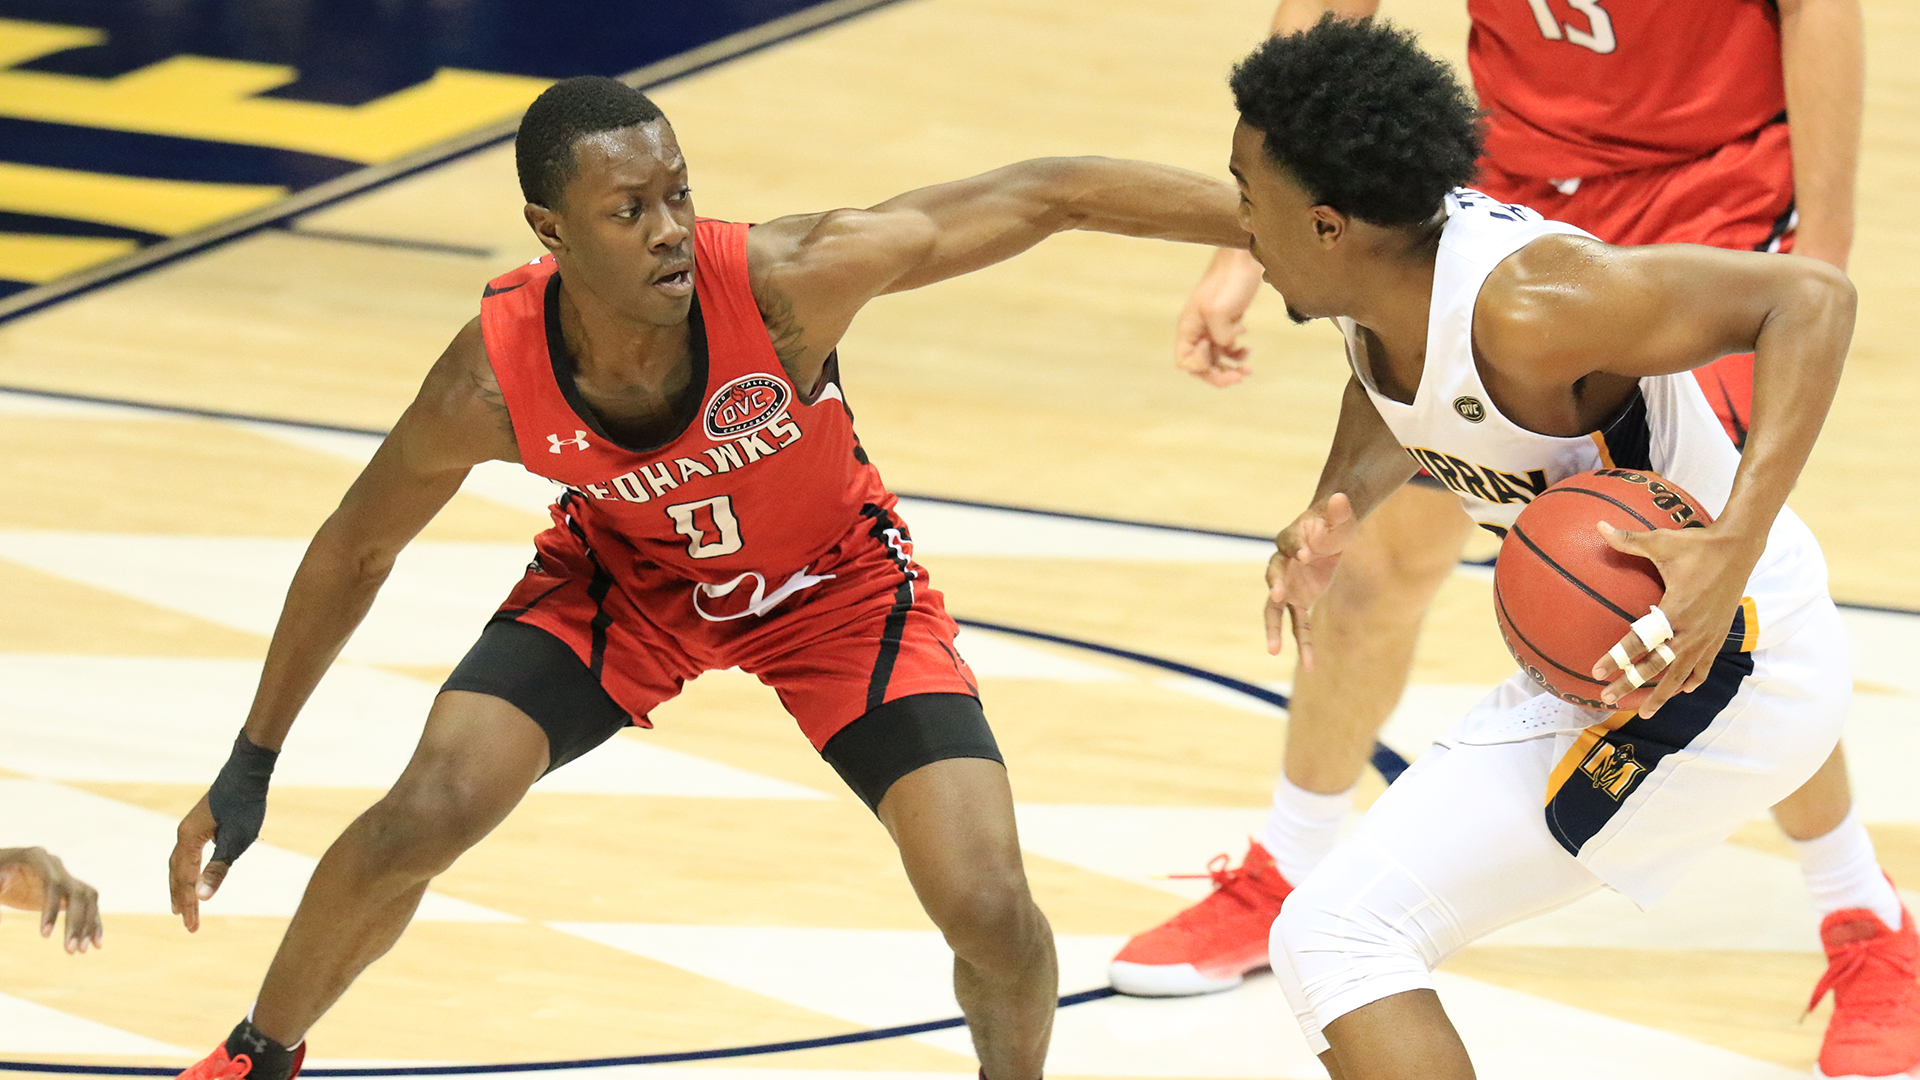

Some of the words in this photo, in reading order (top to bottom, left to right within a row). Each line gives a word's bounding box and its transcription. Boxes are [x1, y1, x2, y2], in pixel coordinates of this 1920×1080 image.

[711, 396, 725, 417] OHIO
[723, 391, 767, 425] OVC
[723, 402, 779, 433] CONFERENCE
[1460, 403, 1480, 415] OVC
[551, 411, 802, 503] EDHAWKS
[664, 495, 744, 560] 0
